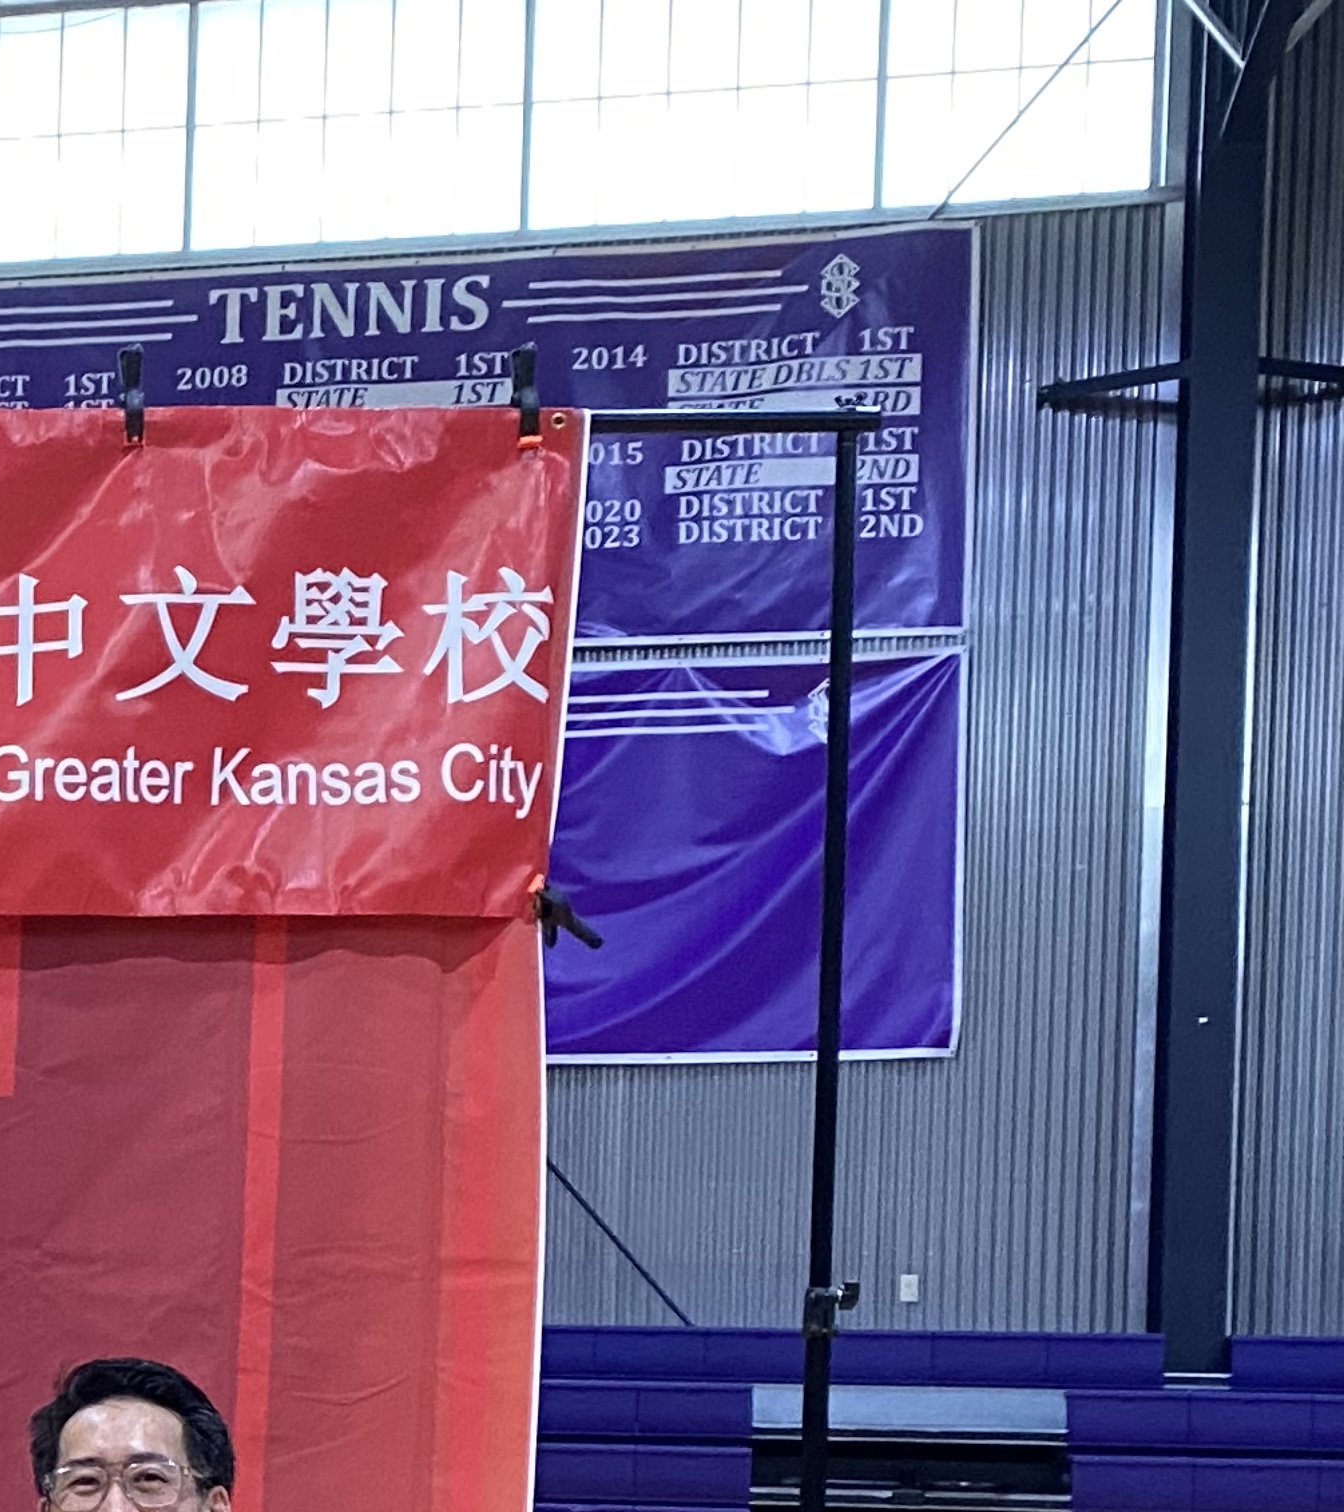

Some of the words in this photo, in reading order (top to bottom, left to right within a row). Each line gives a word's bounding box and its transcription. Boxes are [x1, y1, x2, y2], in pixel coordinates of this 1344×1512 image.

[209, 275, 490, 344] TENNIS
[572, 344, 647, 370] 2014
[676, 332, 819, 366] DISTRICT
[858, 327, 915, 352] 1ST
[64, 372, 115, 397] 1ST
[176, 365, 248, 390] 2008
[283, 356, 419, 385] DISTRICT
[455, 352, 509, 377] 1ST
[676, 367, 765, 394] STATE
[773, 359, 847, 386] DBLS
[857, 357, 914, 381] 1ST
[453, 381, 505, 406] 1ST
[589, 441, 644, 465] 015
[681, 431, 823, 462] DISTRICT
[864, 427, 919, 452] 1ST
[673, 462, 763, 490] STATE
[586, 499, 642, 523] 020
[678, 490, 823, 519] DISTRICT
[861, 486, 917, 511] 1ST
[585, 525, 640, 549] 023
[678, 517, 823, 545] DISTRICT
[860, 514, 924, 539] 2ND
[211, 747, 421, 806] Kansas
[441, 743, 544, 818] City
